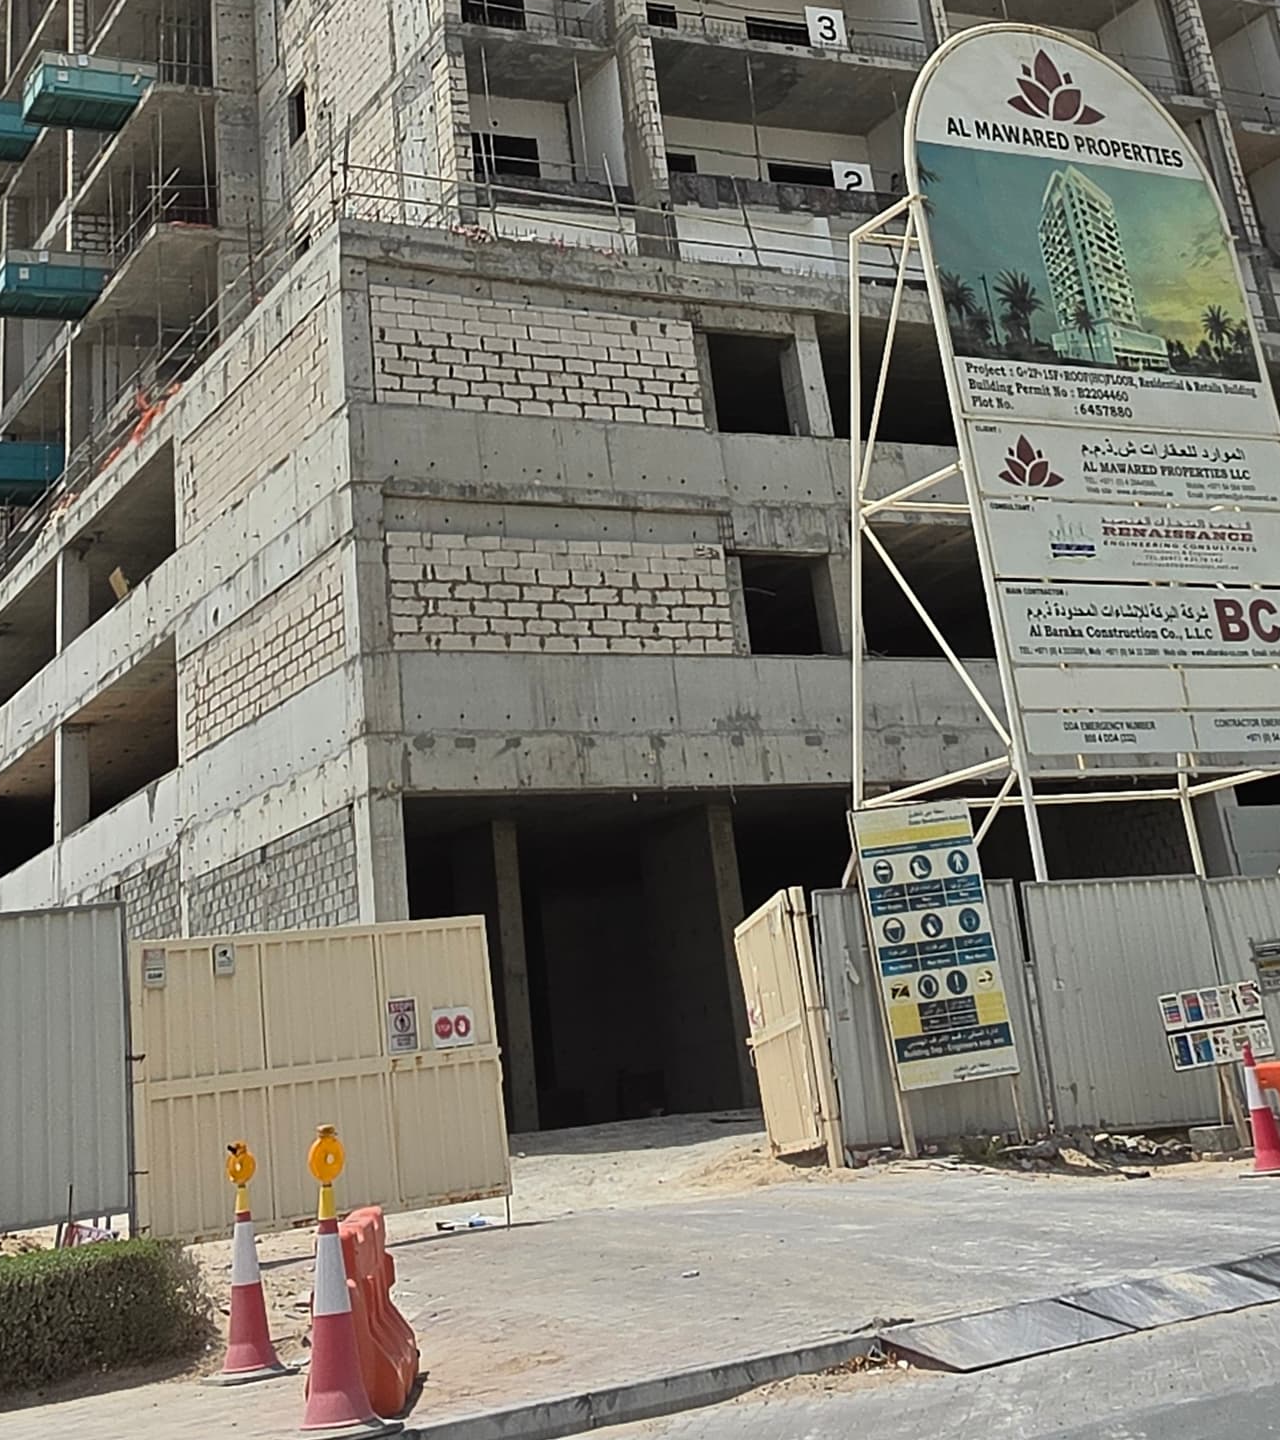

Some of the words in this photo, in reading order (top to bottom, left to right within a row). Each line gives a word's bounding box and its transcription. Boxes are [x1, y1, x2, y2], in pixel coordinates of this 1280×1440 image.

[817, 15, 838, 42] 3
[947, 117, 971, 138] AL
[975, 120, 1070, 150] MAWARED
[1073, 135, 1184, 168] PROPERTIES
[844, 170, 863, 192] 2
[965, 362, 1007, 377] Project
[968, 378, 1014, 395] Building
[1016, 383, 1051, 397] Permit
[1052, 386, 1068, 398] No
[971, 396, 994, 408] Plot
[996, 398, 1014, 410] No.
[1140, 443, 1198, 459] للعقارات
[1202, 447, 1246, 463] الموارد
[1083, 461, 1098, 473] AL
[1099, 462, 1158, 476] MAWARED
[1160, 465, 1228, 480] PROPERTIES
[1230, 469, 1251, 481] LLC
[1102, 526, 1254, 543] RENAISSANCE
[1103, 540, 1180, 549] ENGINEERING
[1183, 542, 1258, 553] CONSULTANTS
[1181, 603, 1209, 622] شركة
[1030, 625, 1041, 638] Al
[1043, 625, 1084, 638] Baraka
[1086, 626, 1159, 639] Construction
